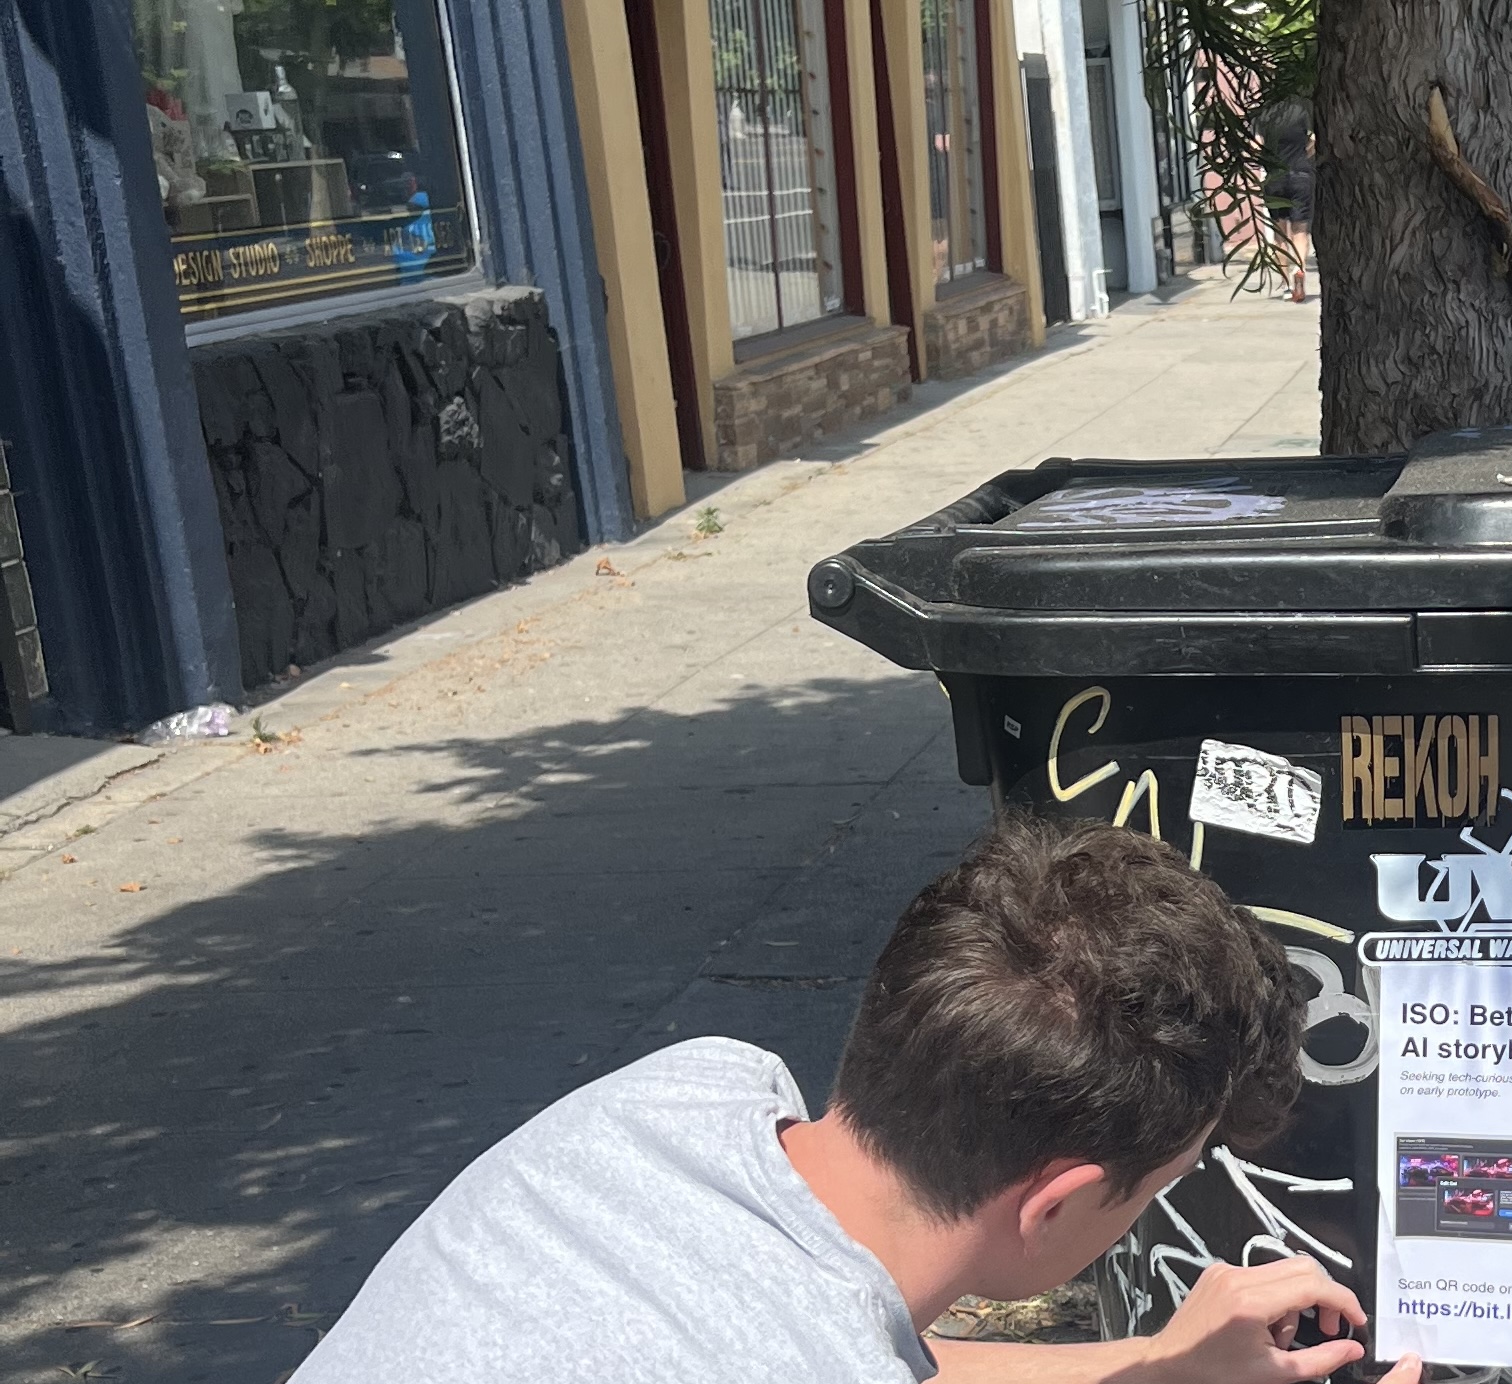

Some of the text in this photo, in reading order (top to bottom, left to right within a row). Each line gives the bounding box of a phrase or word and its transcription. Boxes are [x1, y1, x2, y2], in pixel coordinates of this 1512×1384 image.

[228, 242, 280, 279] STUDIO
[304, 233, 355, 268] SHOPPE
[1341, 714, 1500, 824] REKOH
[1375, 938, 1483, 960] UNIVERSAL
[1401, 1002, 1459, 1026] ISO:
[1400, 1037, 1428, 1058] AI
[1400, 1070, 1446, 1084] Seeking
[1399, 1085, 1501, 1100] on early prototype.
[1398, 1278, 1432, 1291] Scan
[1435, 1279, 1459, 1292] QR
[1462, 1281, 1495, 1294] code
[1498, 1284, 1512, 1295] or
